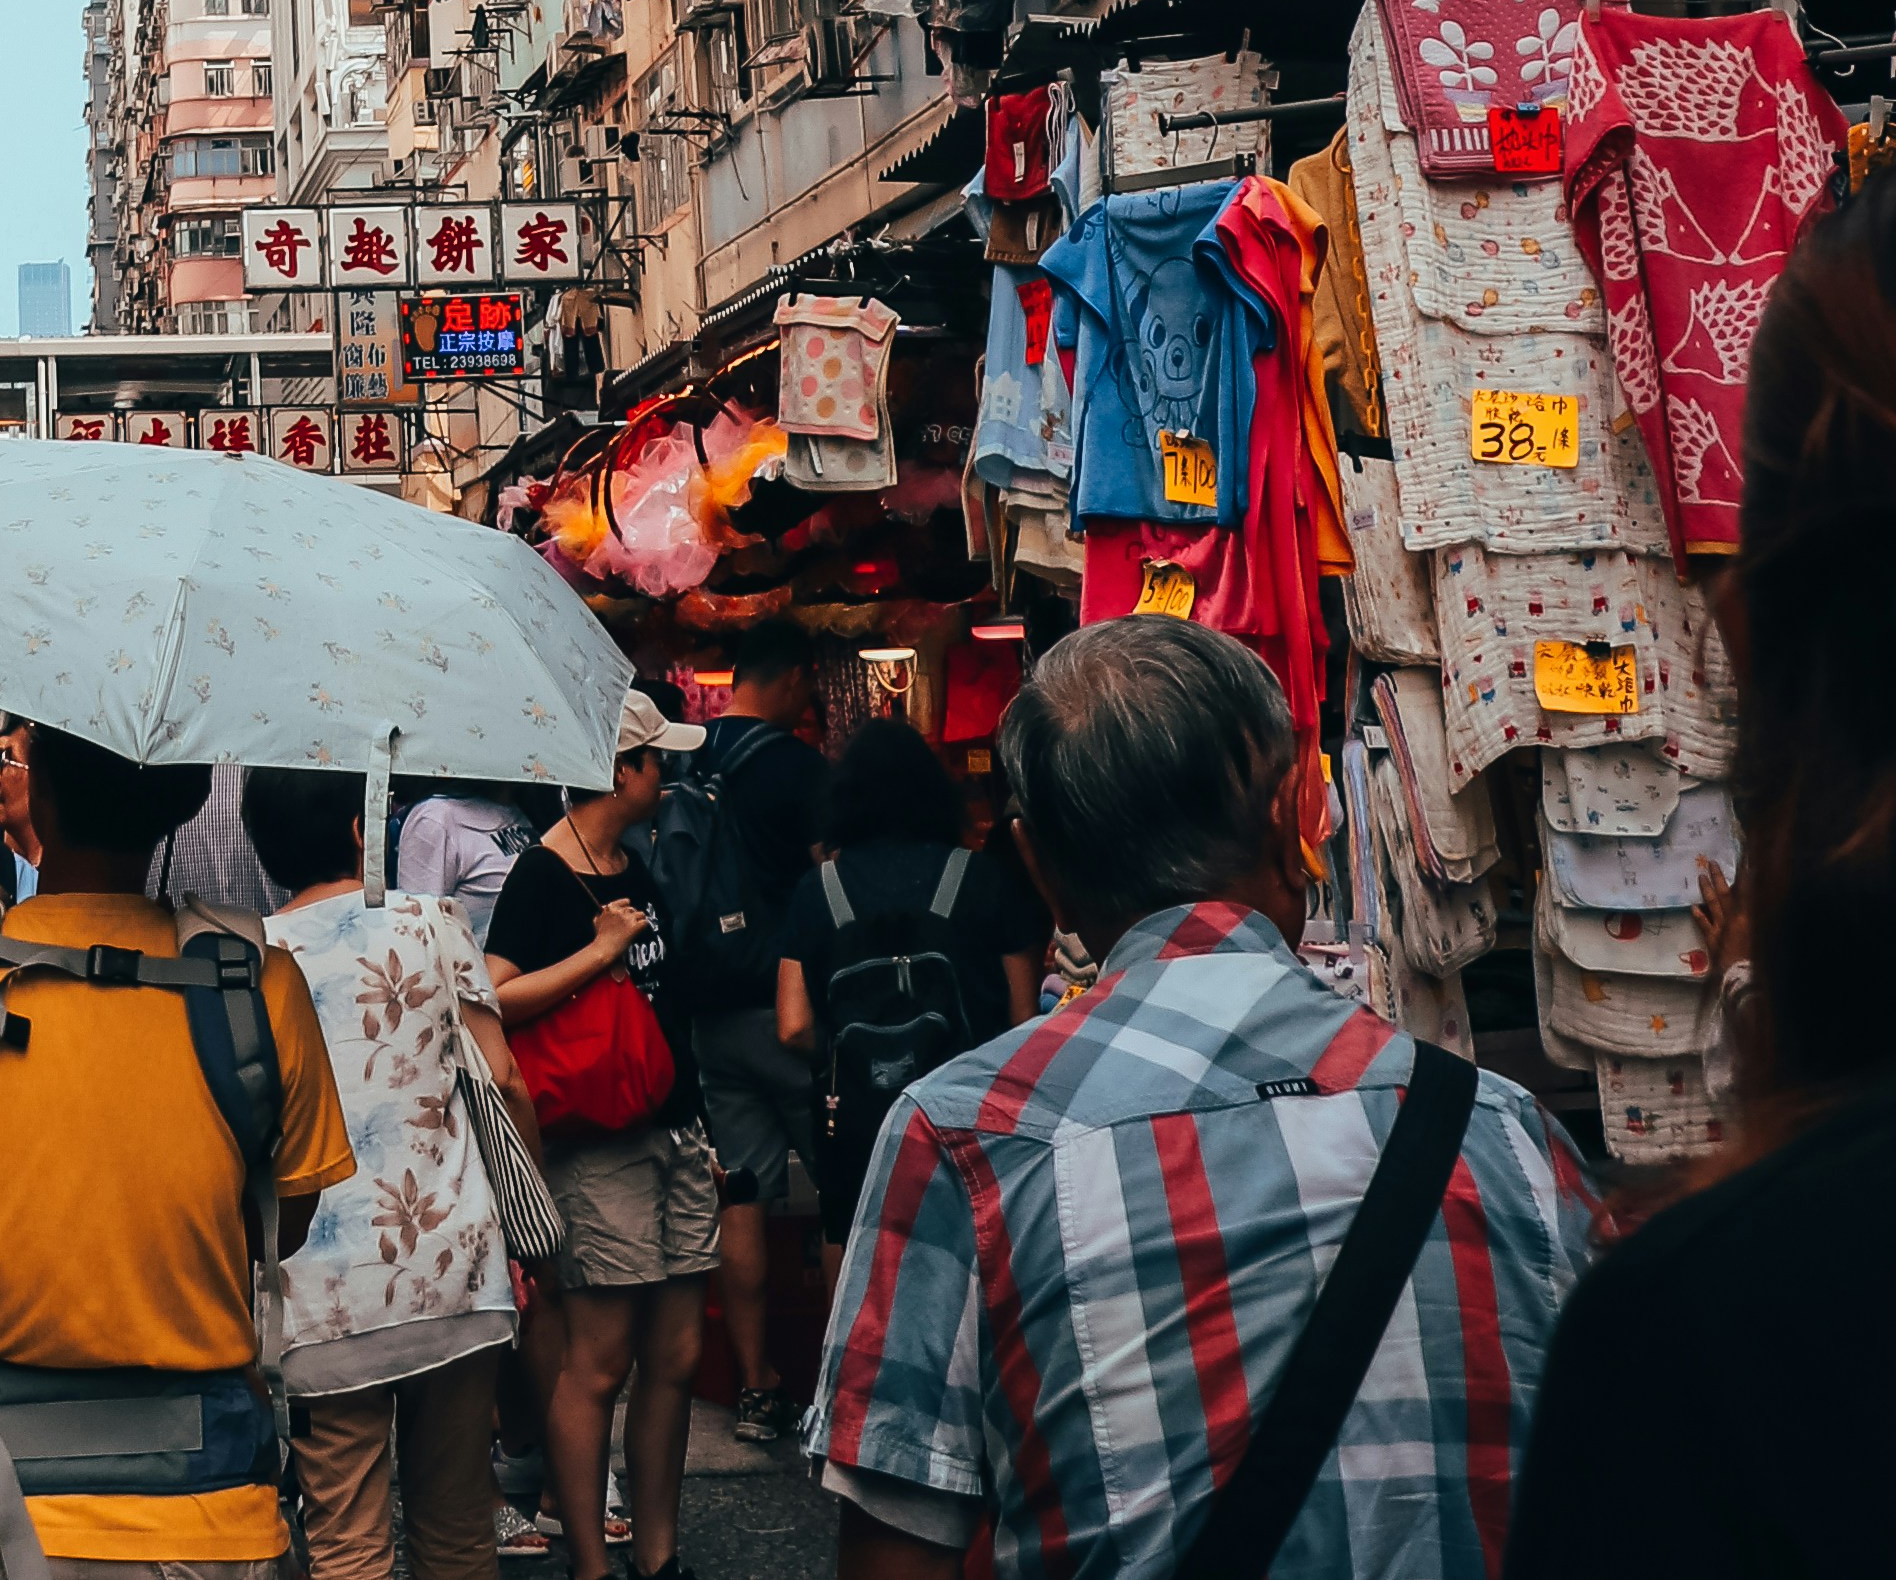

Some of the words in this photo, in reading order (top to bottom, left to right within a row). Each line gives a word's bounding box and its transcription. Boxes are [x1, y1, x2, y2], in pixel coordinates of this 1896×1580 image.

[254, 211, 569, 279] 奇趣餅家
[439, 330, 516, 353] 正宗按摩
